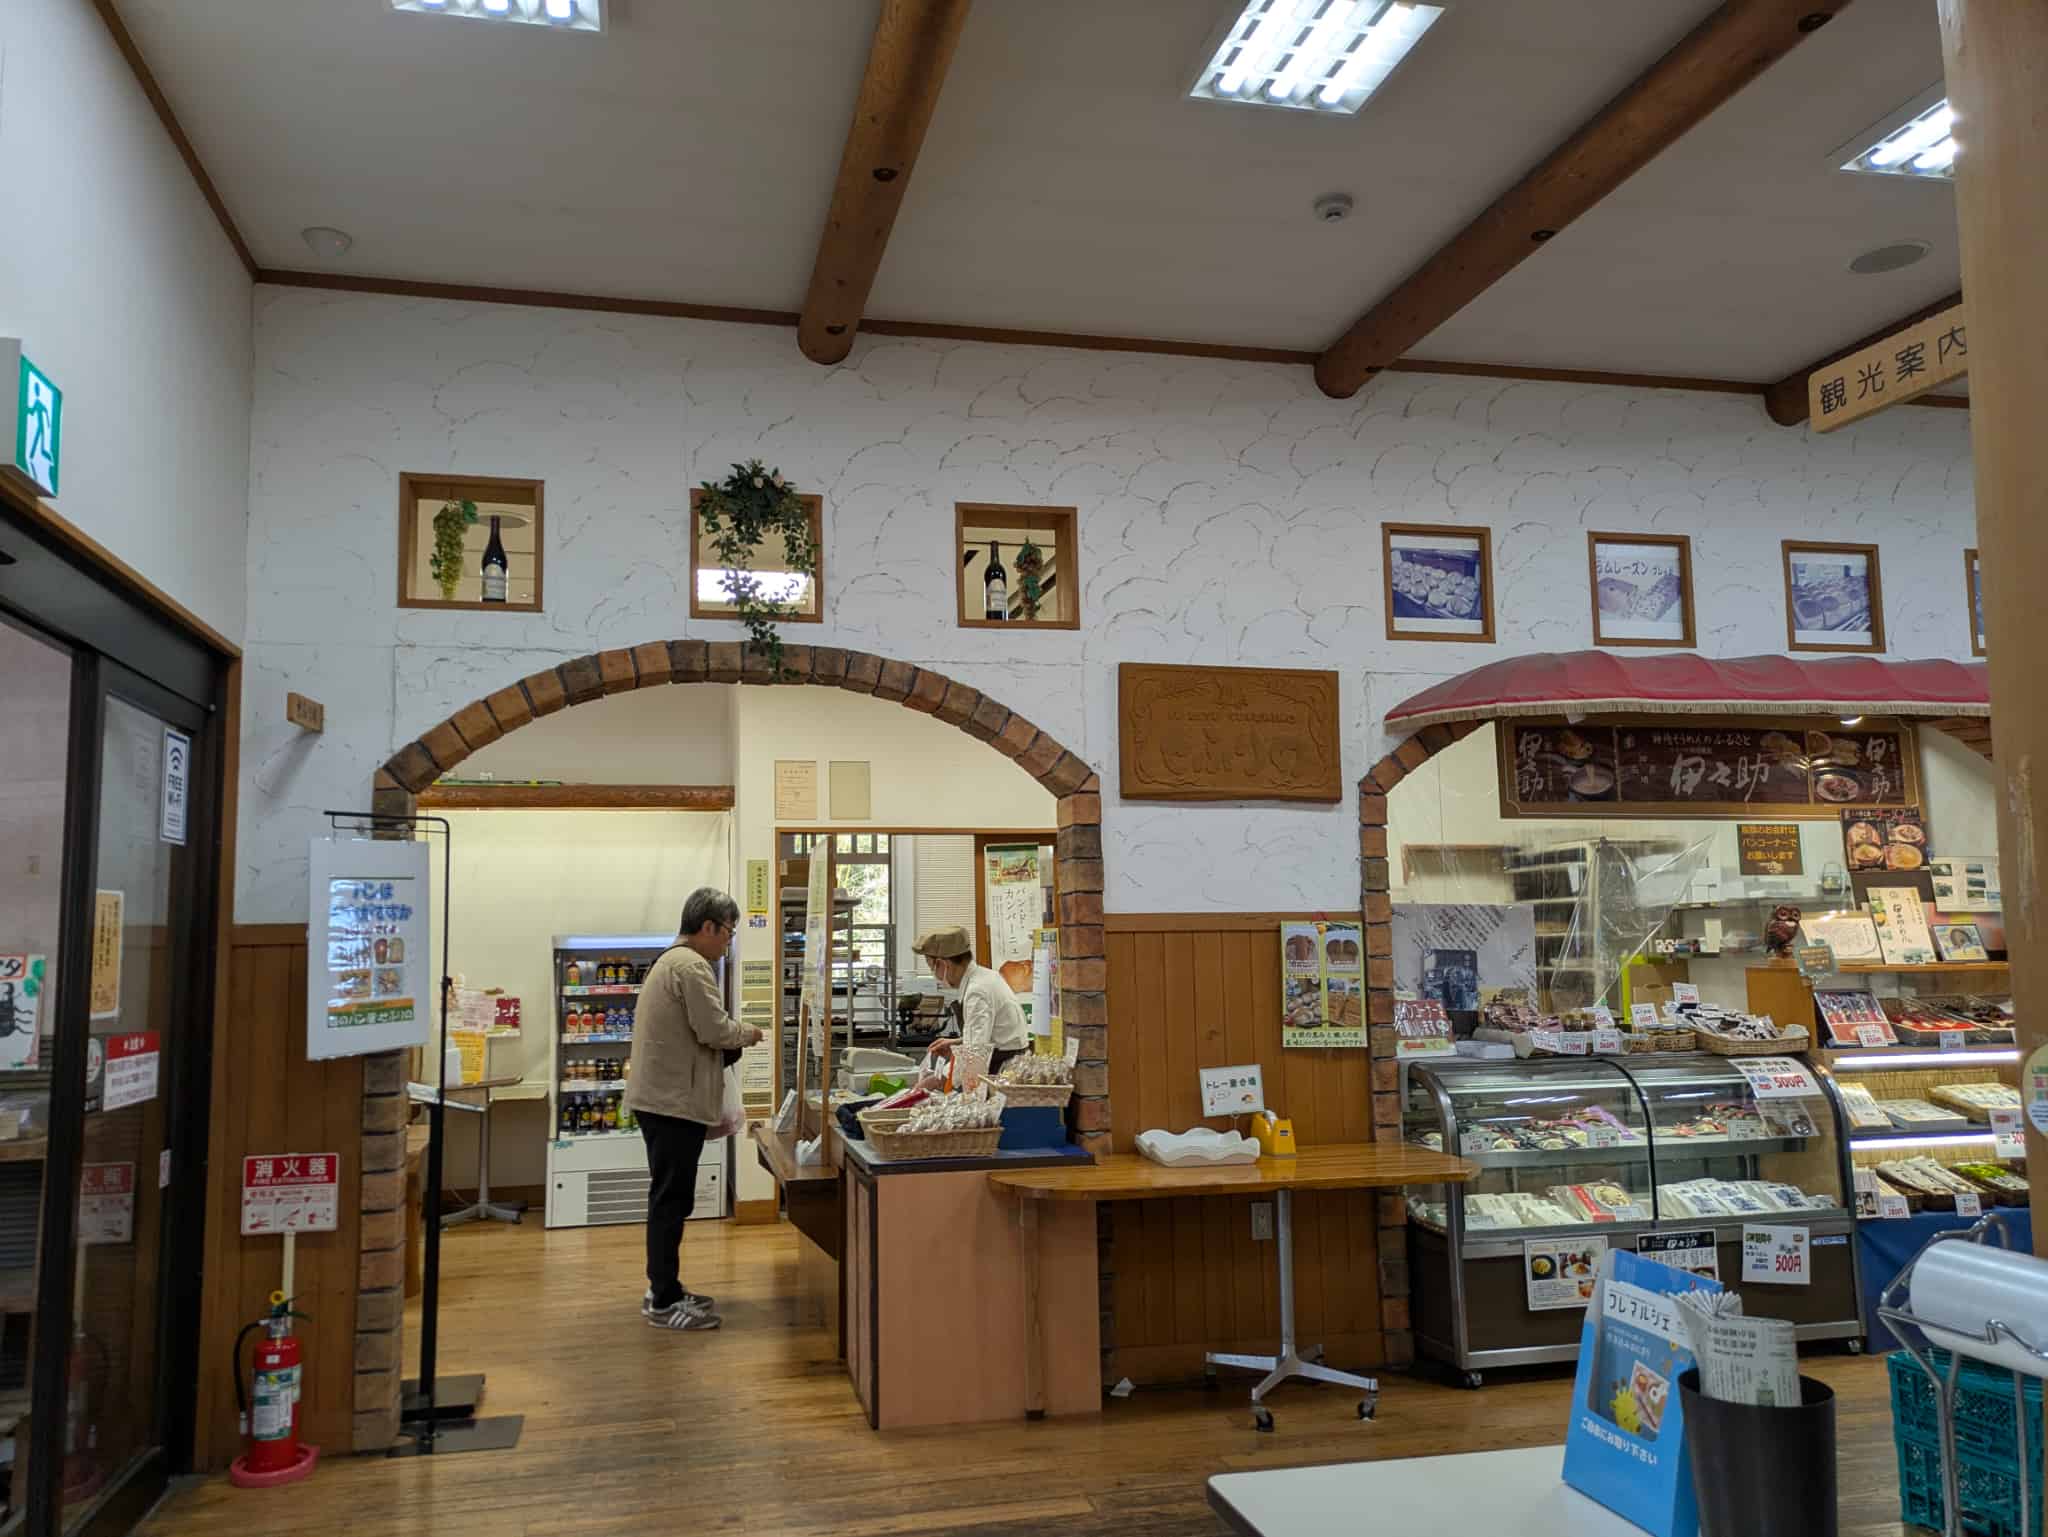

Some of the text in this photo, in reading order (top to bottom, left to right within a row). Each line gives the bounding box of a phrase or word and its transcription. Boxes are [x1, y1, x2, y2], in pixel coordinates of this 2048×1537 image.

[1819, 326, 1967, 415] 観光案内
[1773, 1075, 1808, 1088] 500円
[255, 1157, 327, 1178] 消火器
[1775, 1254, 1802, 1272] 500円
